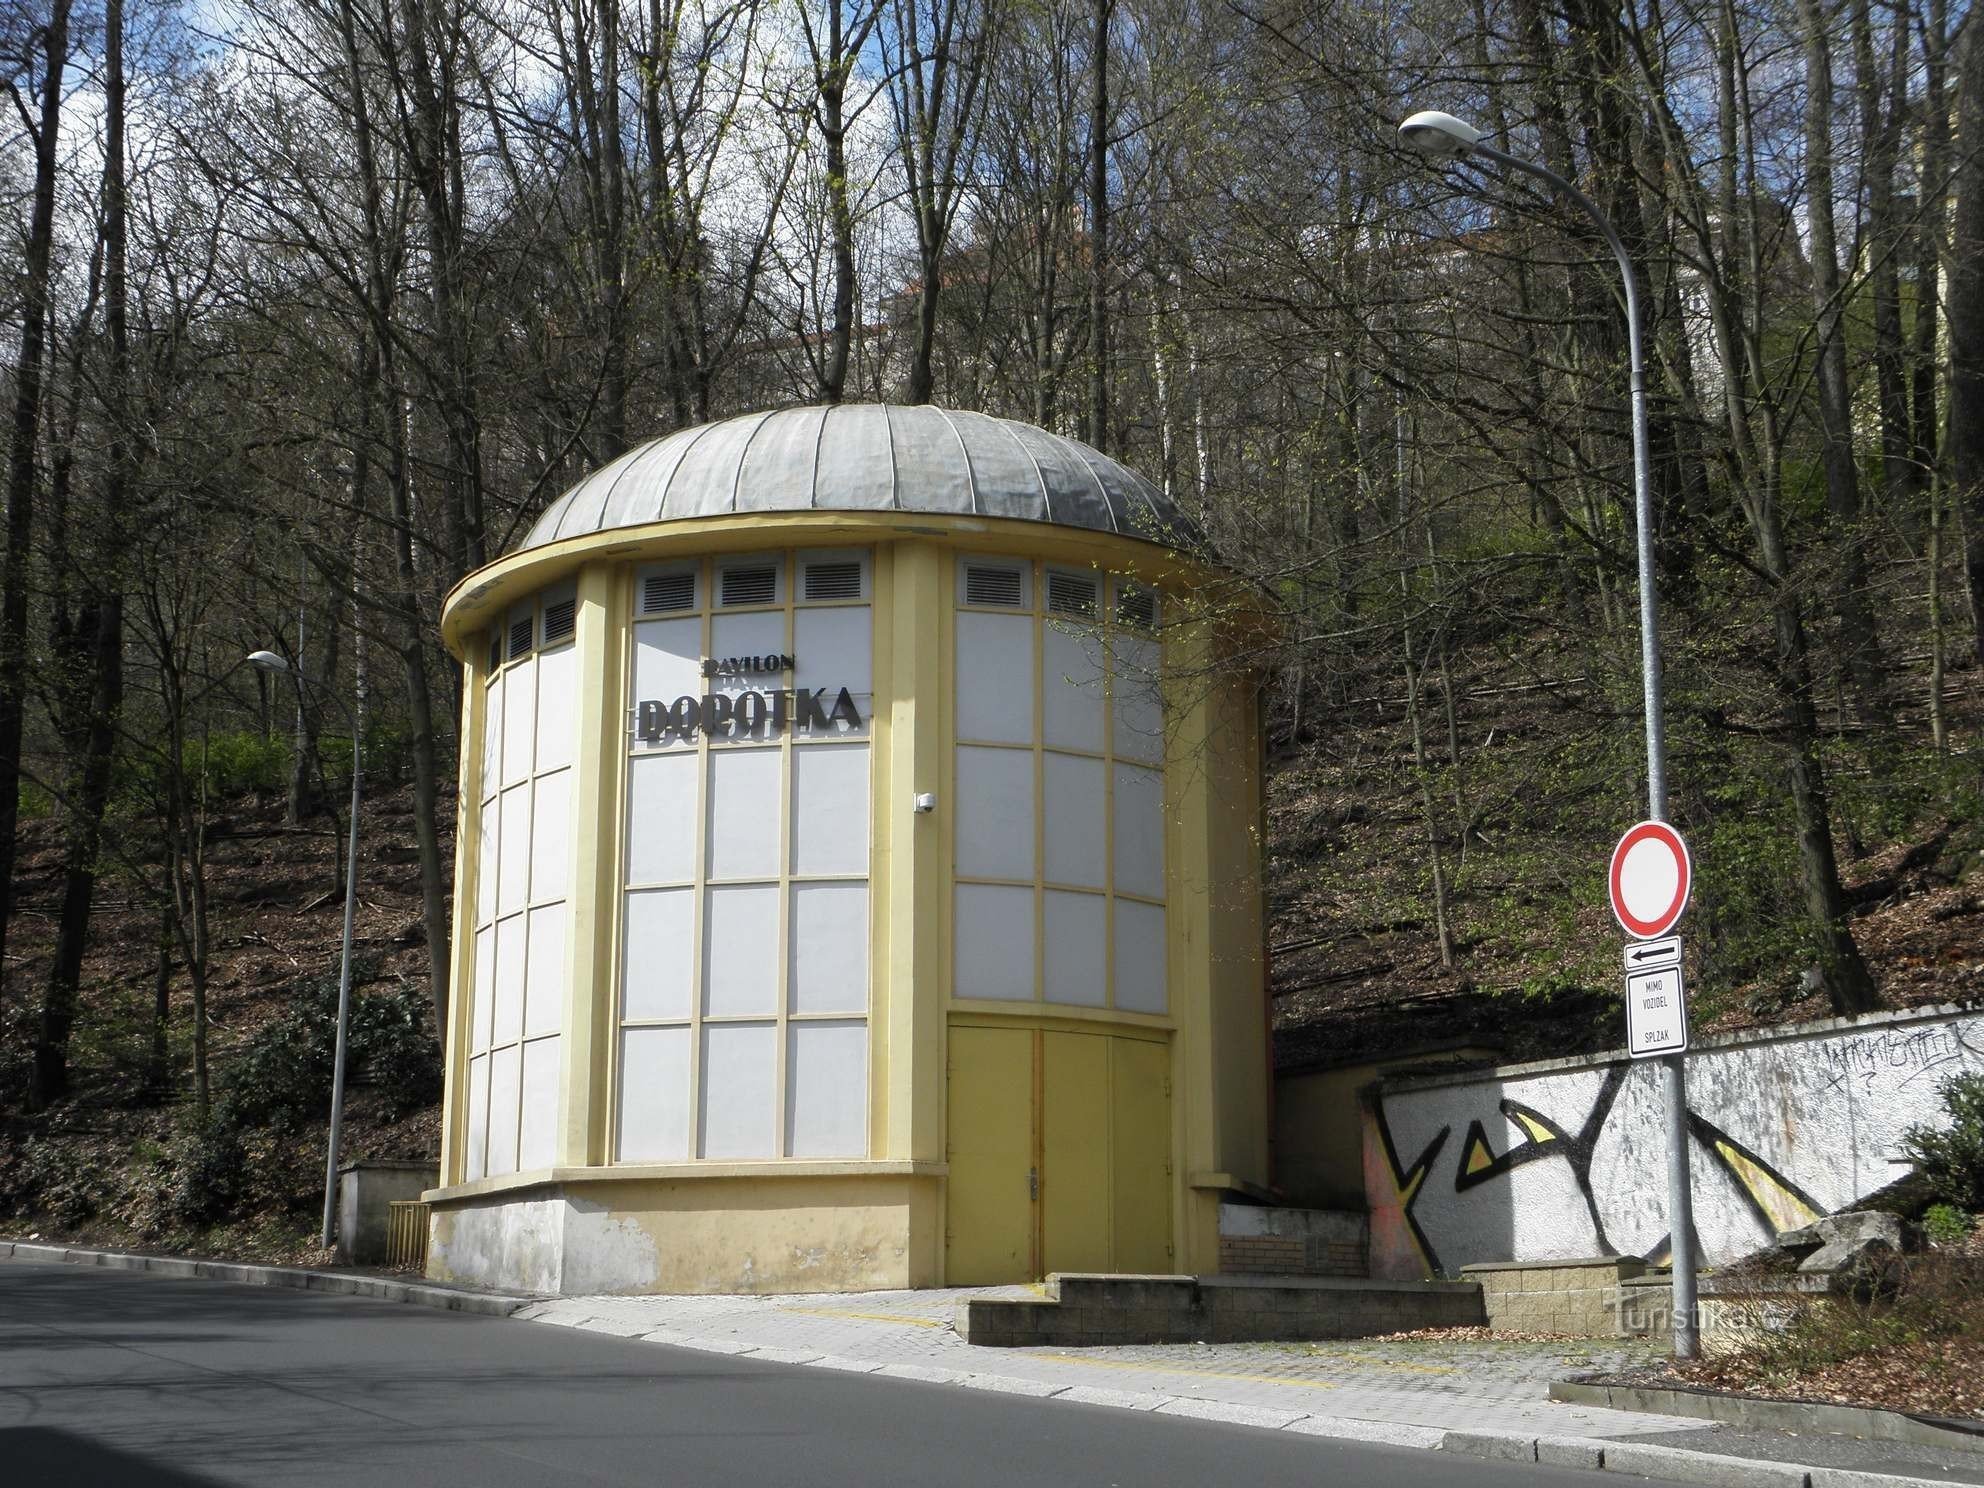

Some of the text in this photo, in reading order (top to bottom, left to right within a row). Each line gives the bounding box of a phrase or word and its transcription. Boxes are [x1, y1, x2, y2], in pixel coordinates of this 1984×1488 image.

[703, 653, 795, 677] PAVILON
[638, 687, 863, 740] DOROTKA
[1645, 980, 1663, 992] MIMO
[1643, 996, 1668, 1010] VOZIDEL
[1644, 1029, 1670, 1043] SPLZAK
